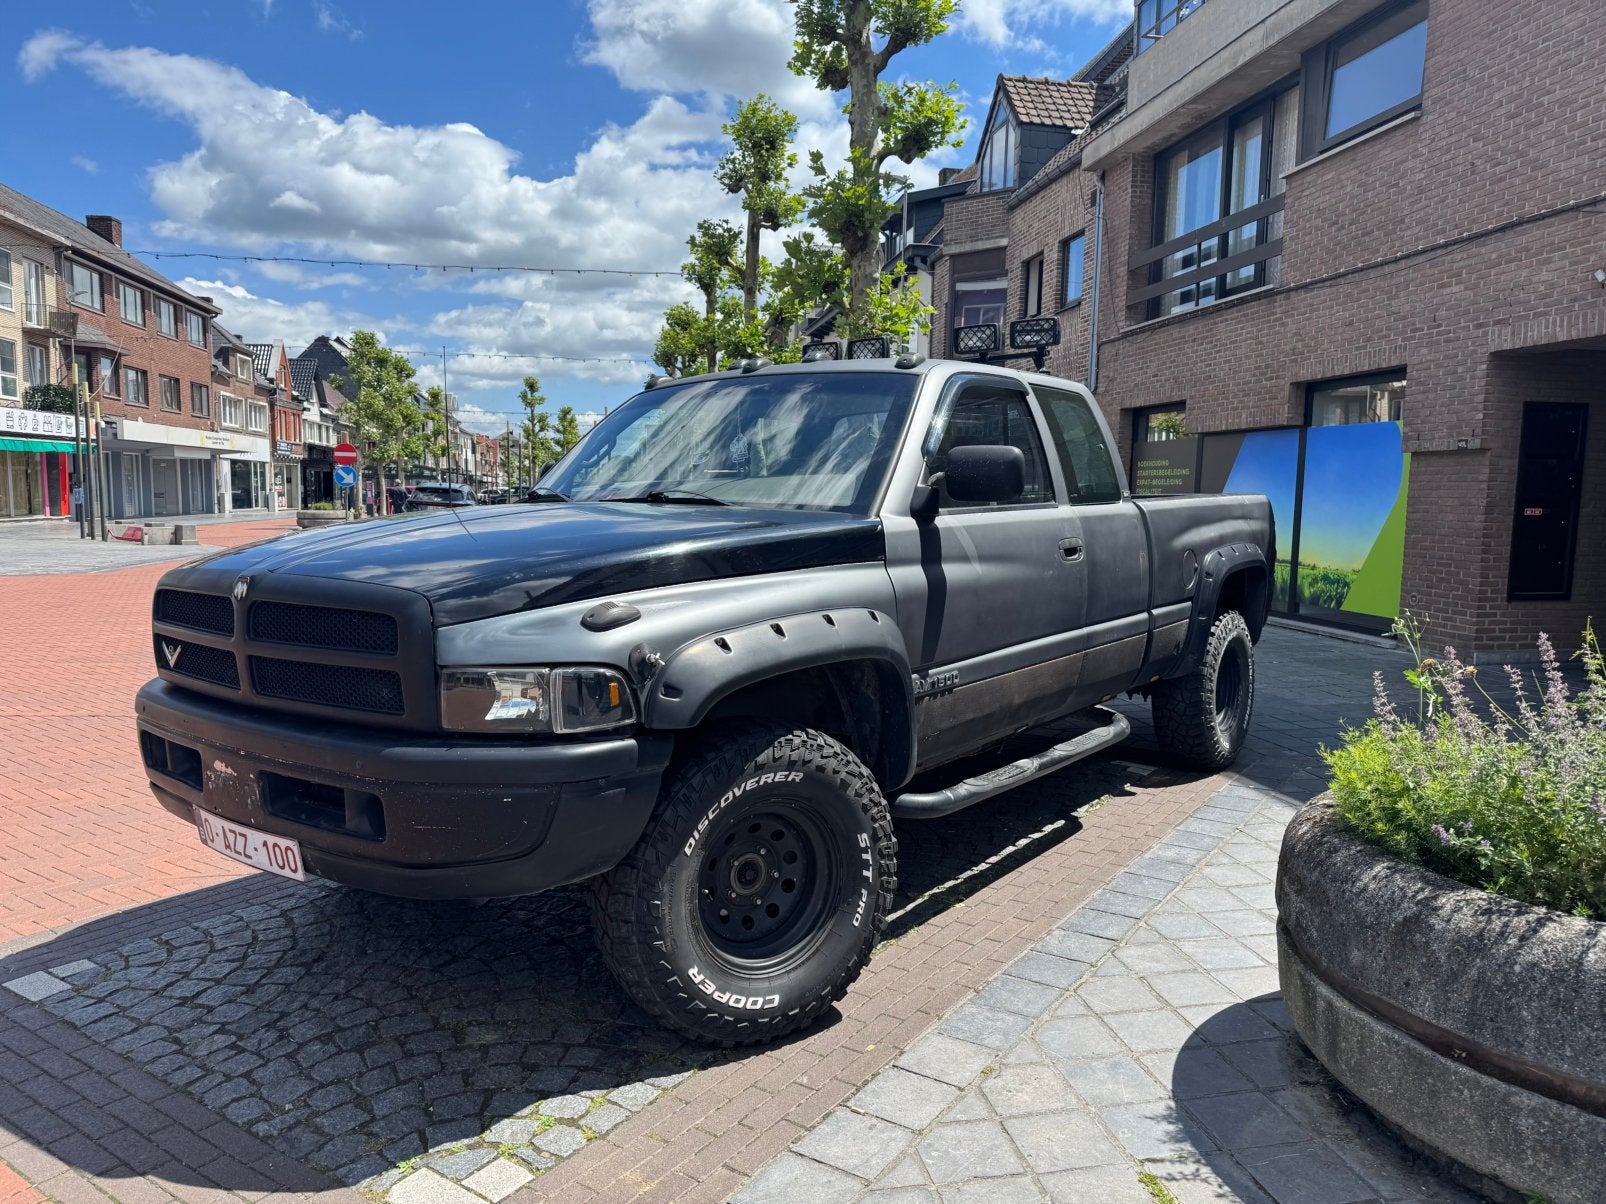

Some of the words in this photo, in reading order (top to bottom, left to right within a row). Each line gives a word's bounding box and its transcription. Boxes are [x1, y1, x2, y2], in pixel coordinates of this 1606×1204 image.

[685, 771, 804, 857] DISCOVERER
[857, 832, 873, 883] STT
[853, 888, 867, 928] PRO
[688, 965, 780, 1011] COOPER
